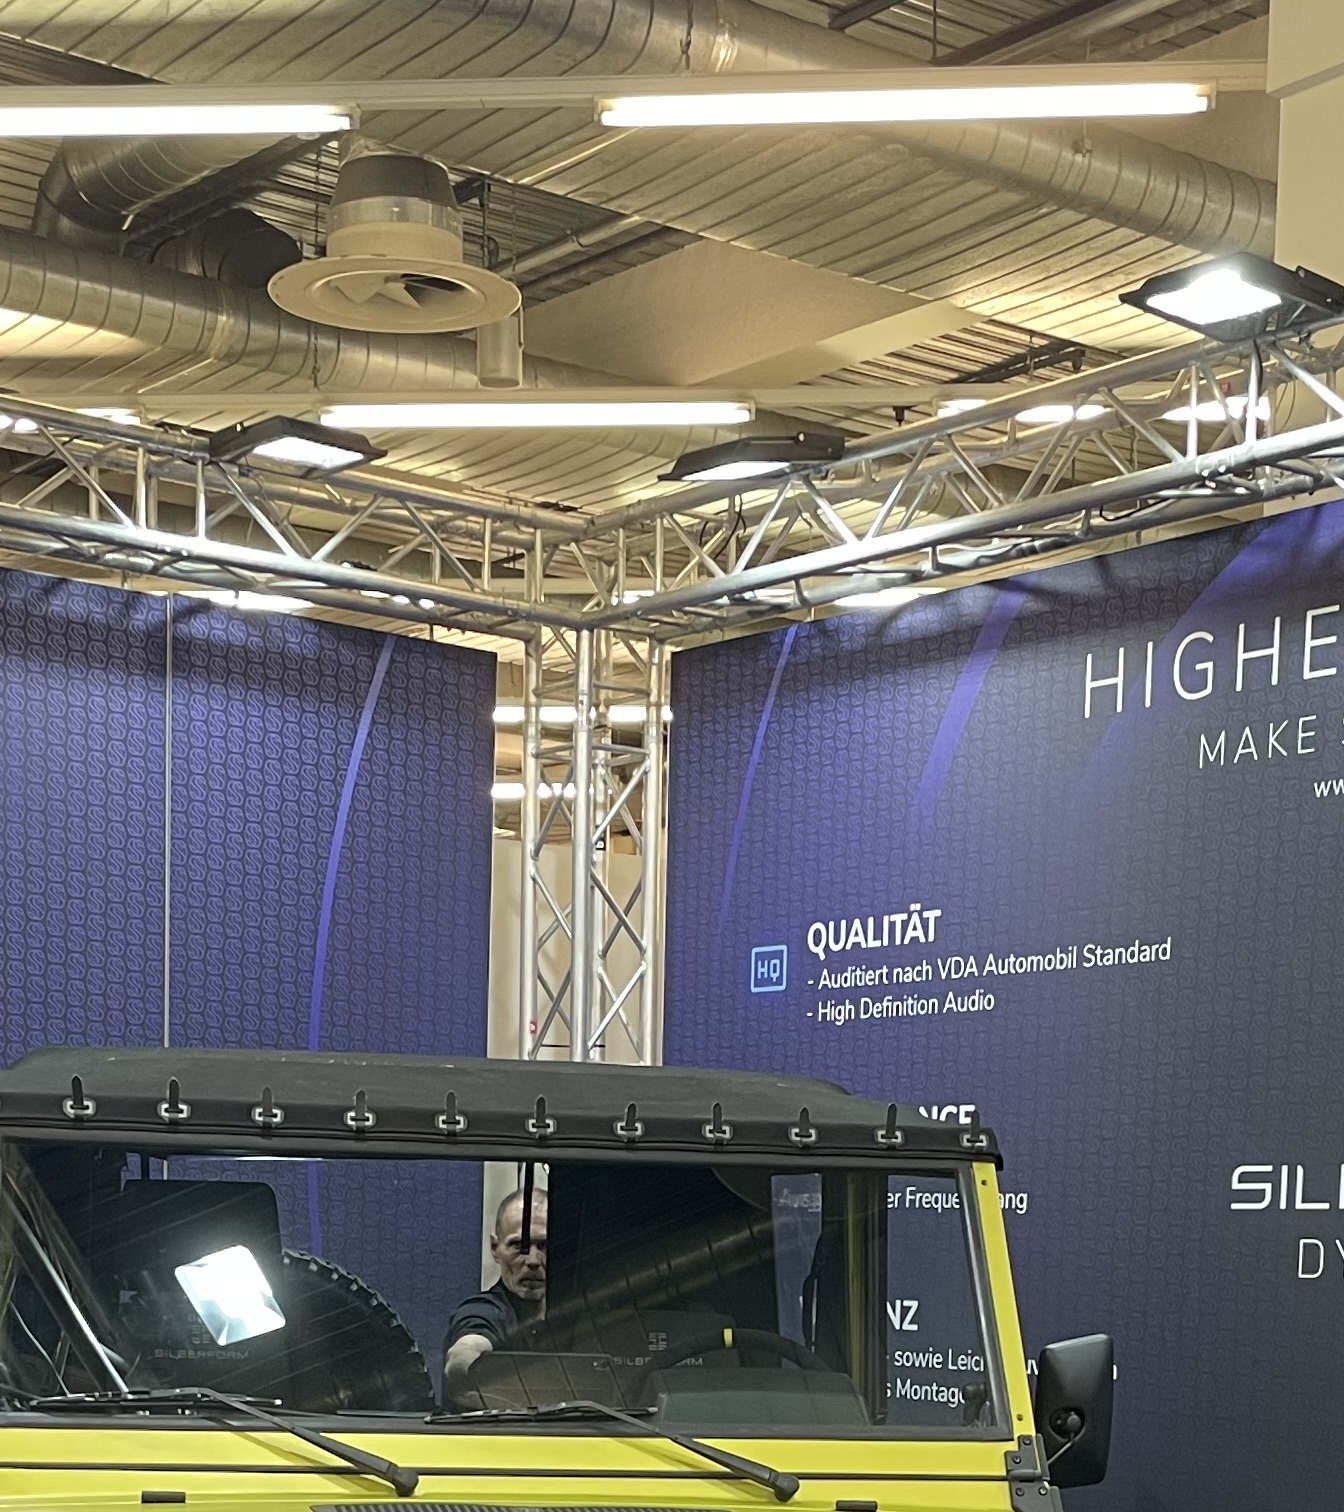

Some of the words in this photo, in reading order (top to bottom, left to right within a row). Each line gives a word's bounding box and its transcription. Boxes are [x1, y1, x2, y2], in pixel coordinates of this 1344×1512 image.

[1198, 713, 1316, 769] MAKE
[806, 903, 942, 961] QUALITÄT
[818, 965, 889, 990] Auditiert
[893, 963, 933, 984] nach
[937, 955, 978, 979] VDA
[983, 945, 1077, 976] Automobil
[1082, 937, 1172, 968] Standard
[817, 999, 855, 1026] High
[859, 993, 939, 1020] Definition
[943, 989, 995, 1013] Audio
[893, 1346, 943, 1369] sowie
